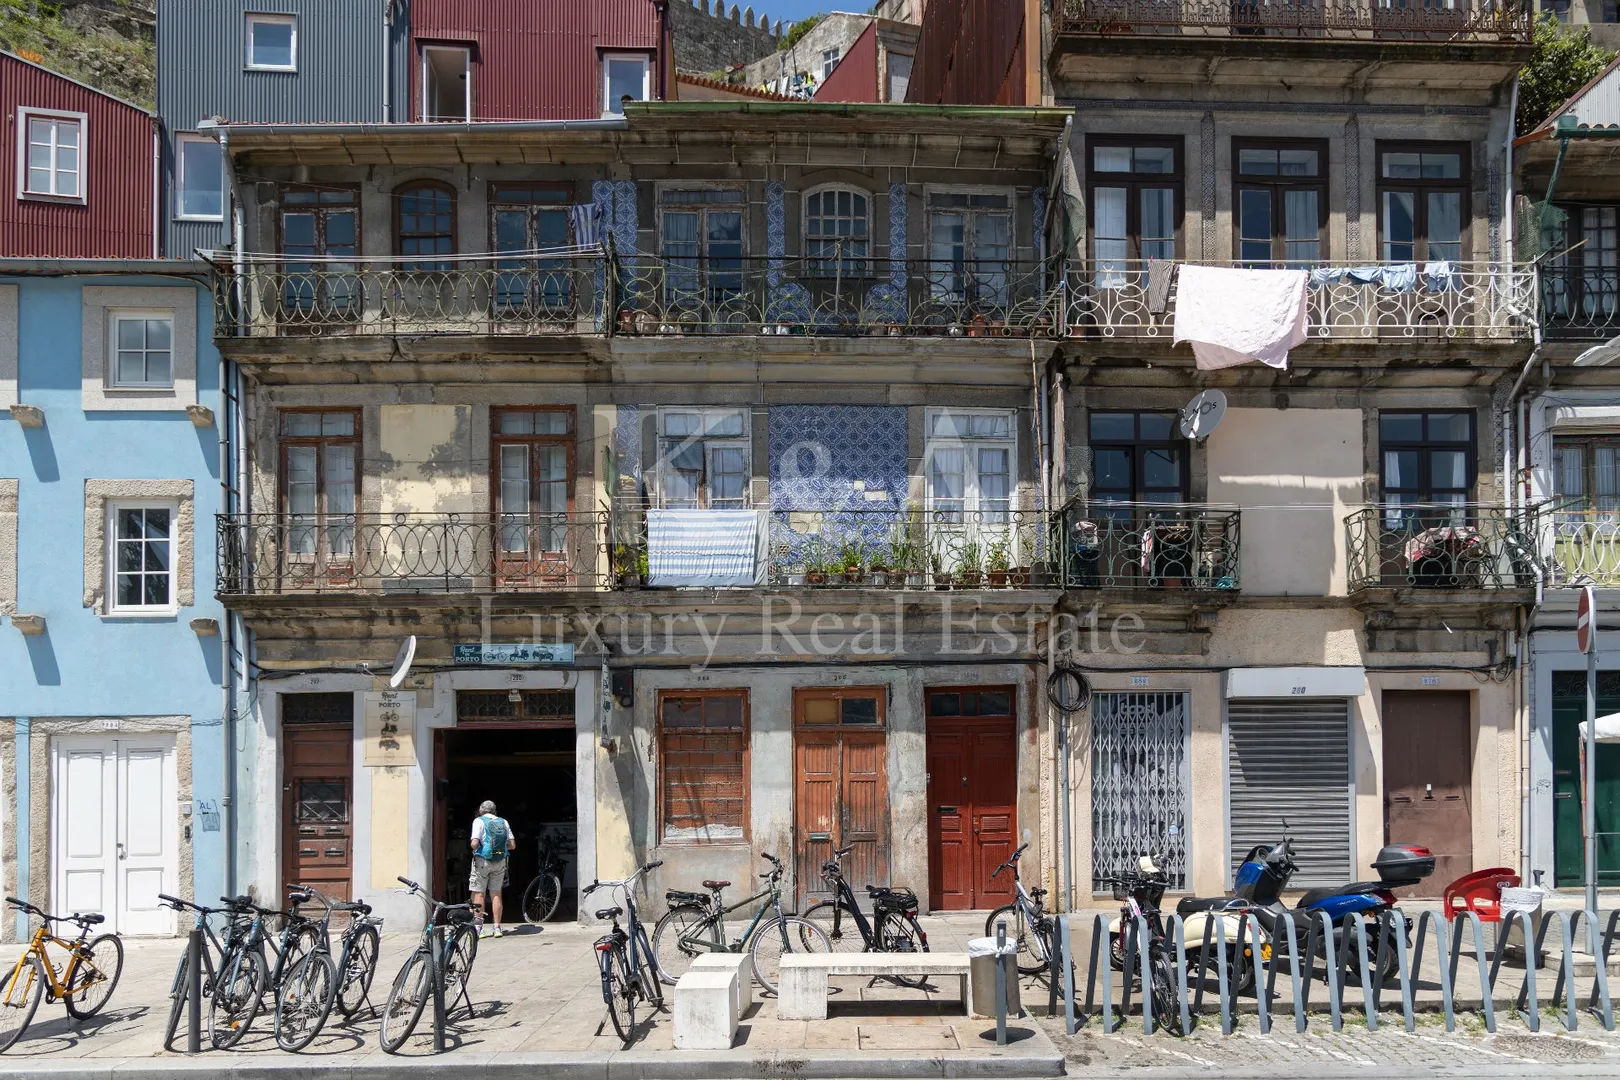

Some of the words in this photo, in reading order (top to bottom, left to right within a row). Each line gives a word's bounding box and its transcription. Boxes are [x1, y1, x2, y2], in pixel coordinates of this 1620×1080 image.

[1192, 401, 1217, 416] NOS
[459, 645, 475, 655] Rent
[381, 691, 398, 701] Rent
[199, 801, 212, 811] AL
